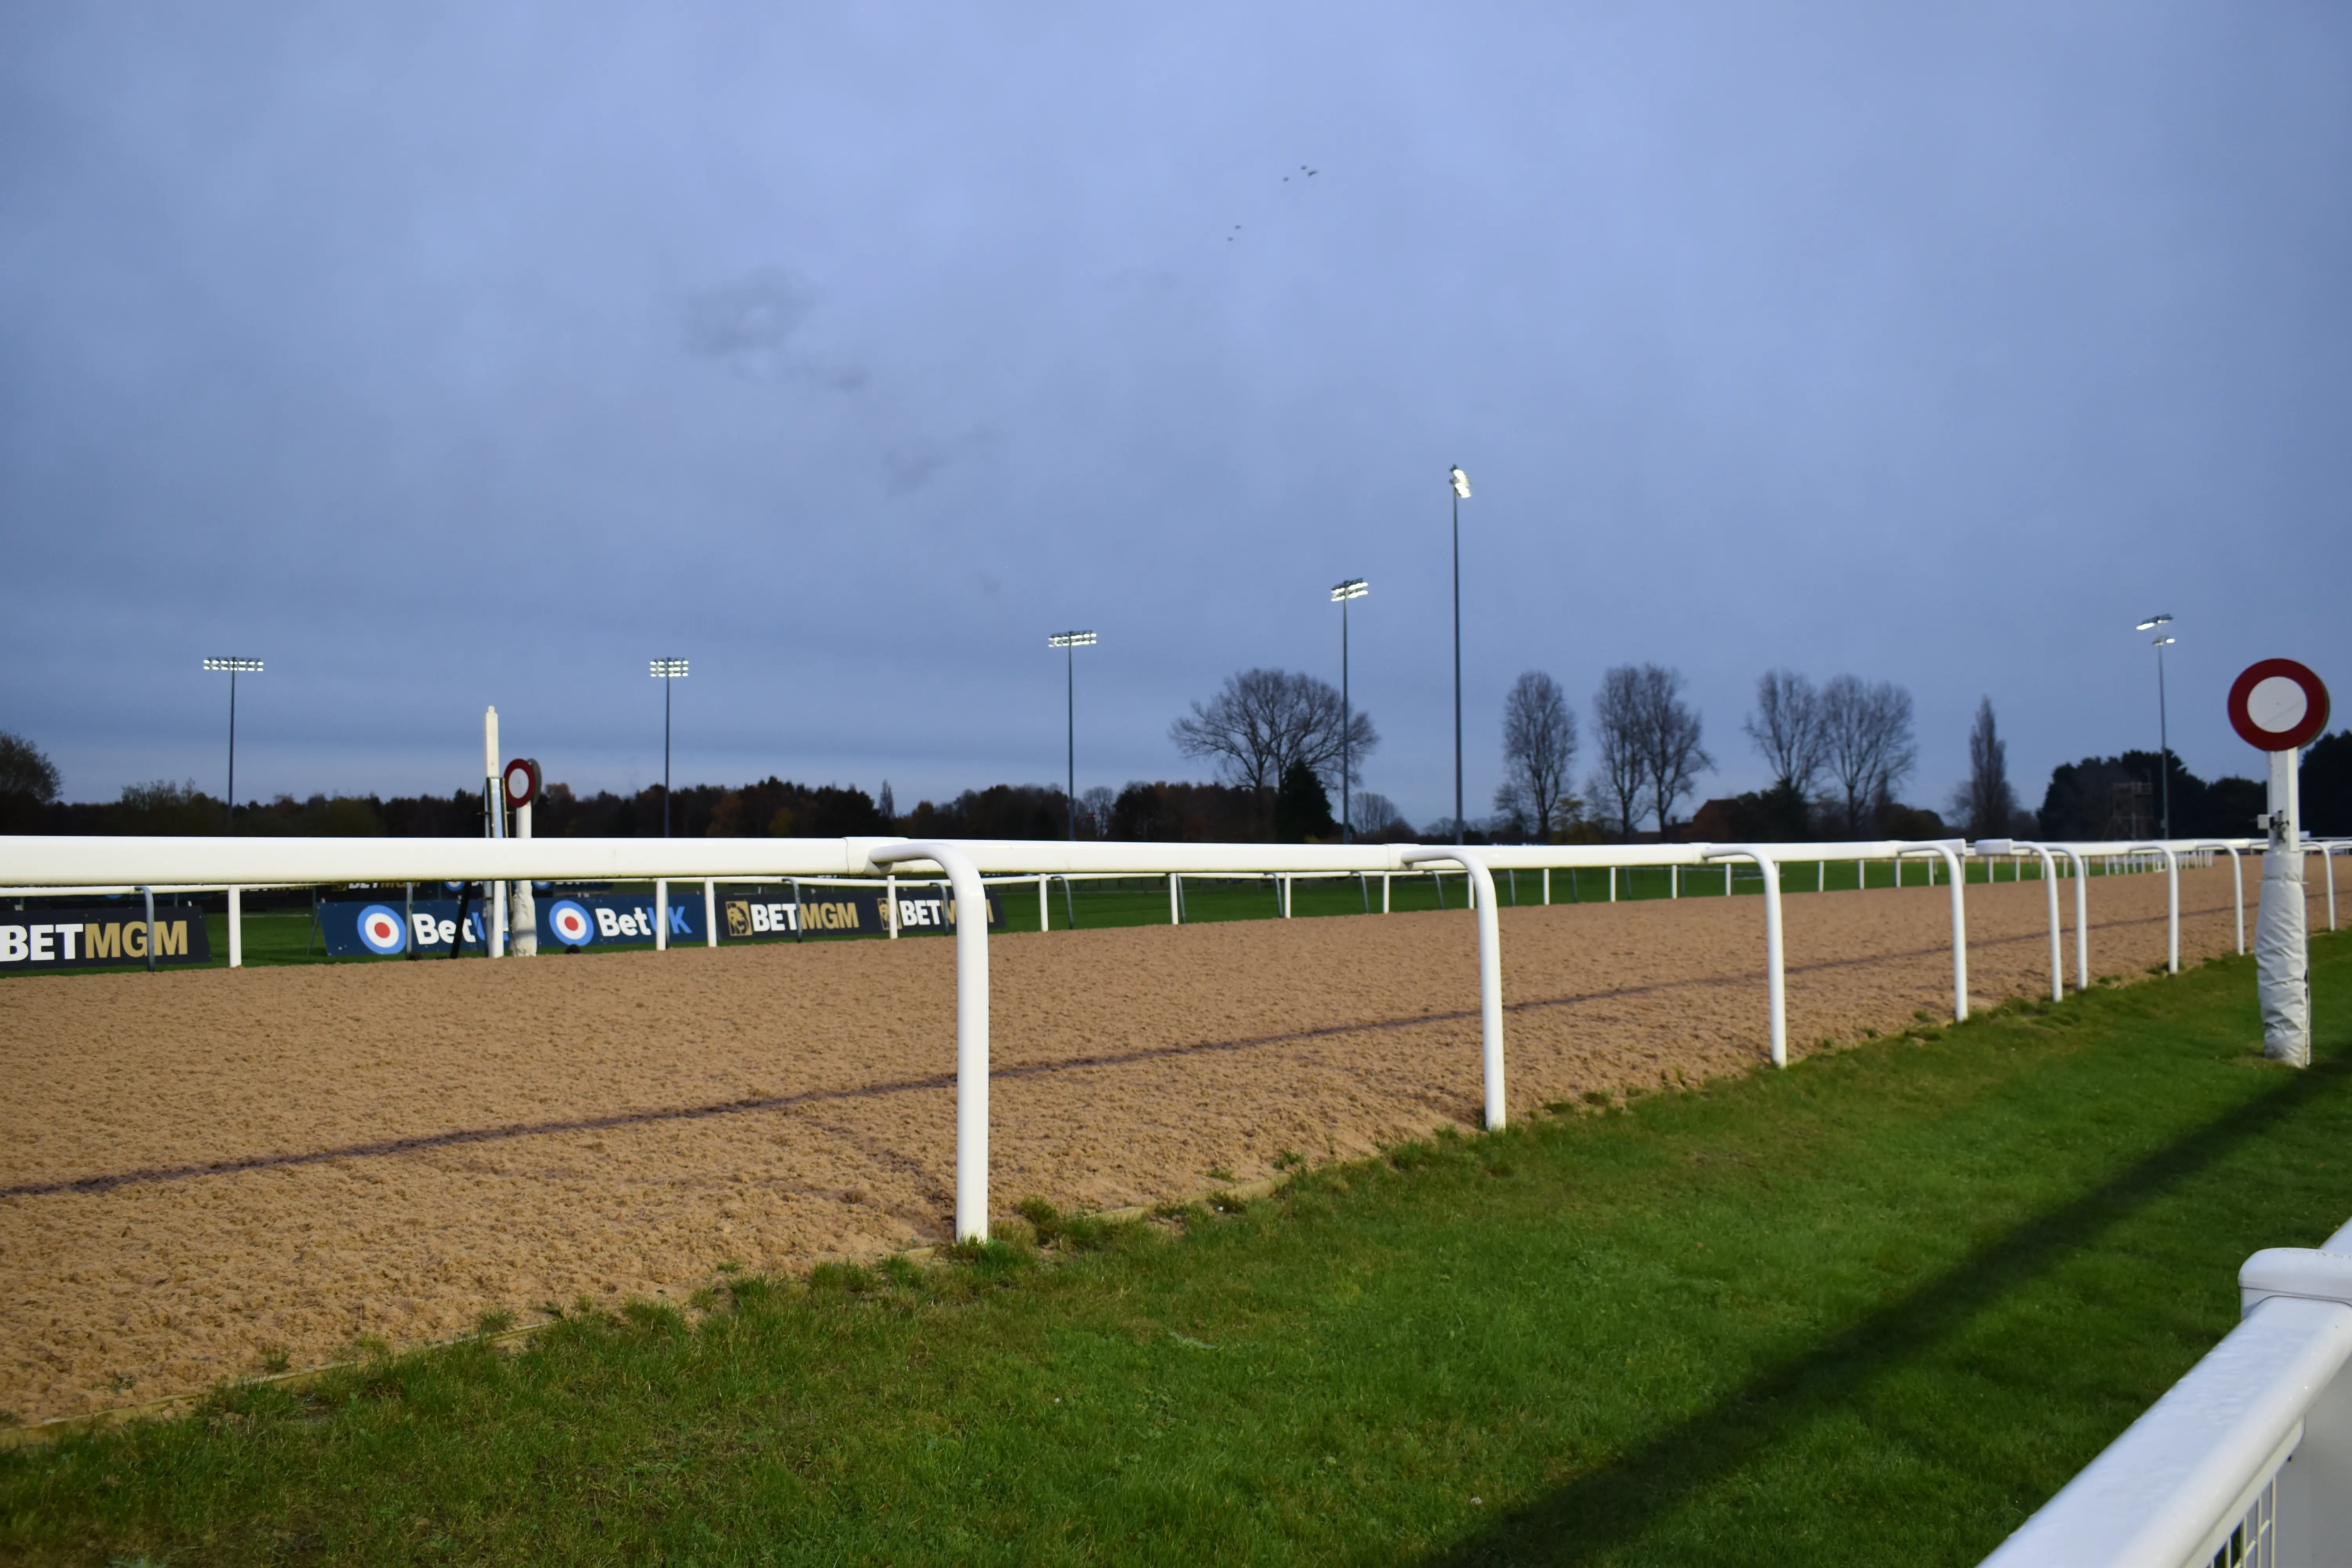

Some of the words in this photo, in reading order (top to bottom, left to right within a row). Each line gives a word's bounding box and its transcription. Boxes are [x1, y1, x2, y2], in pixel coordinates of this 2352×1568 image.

[750, 902, 859, 931] BETMGM
[899, 899, 994, 926] BET
[0, 920, 187, 961] BETMGM
[412, 912, 509, 944] Bet
